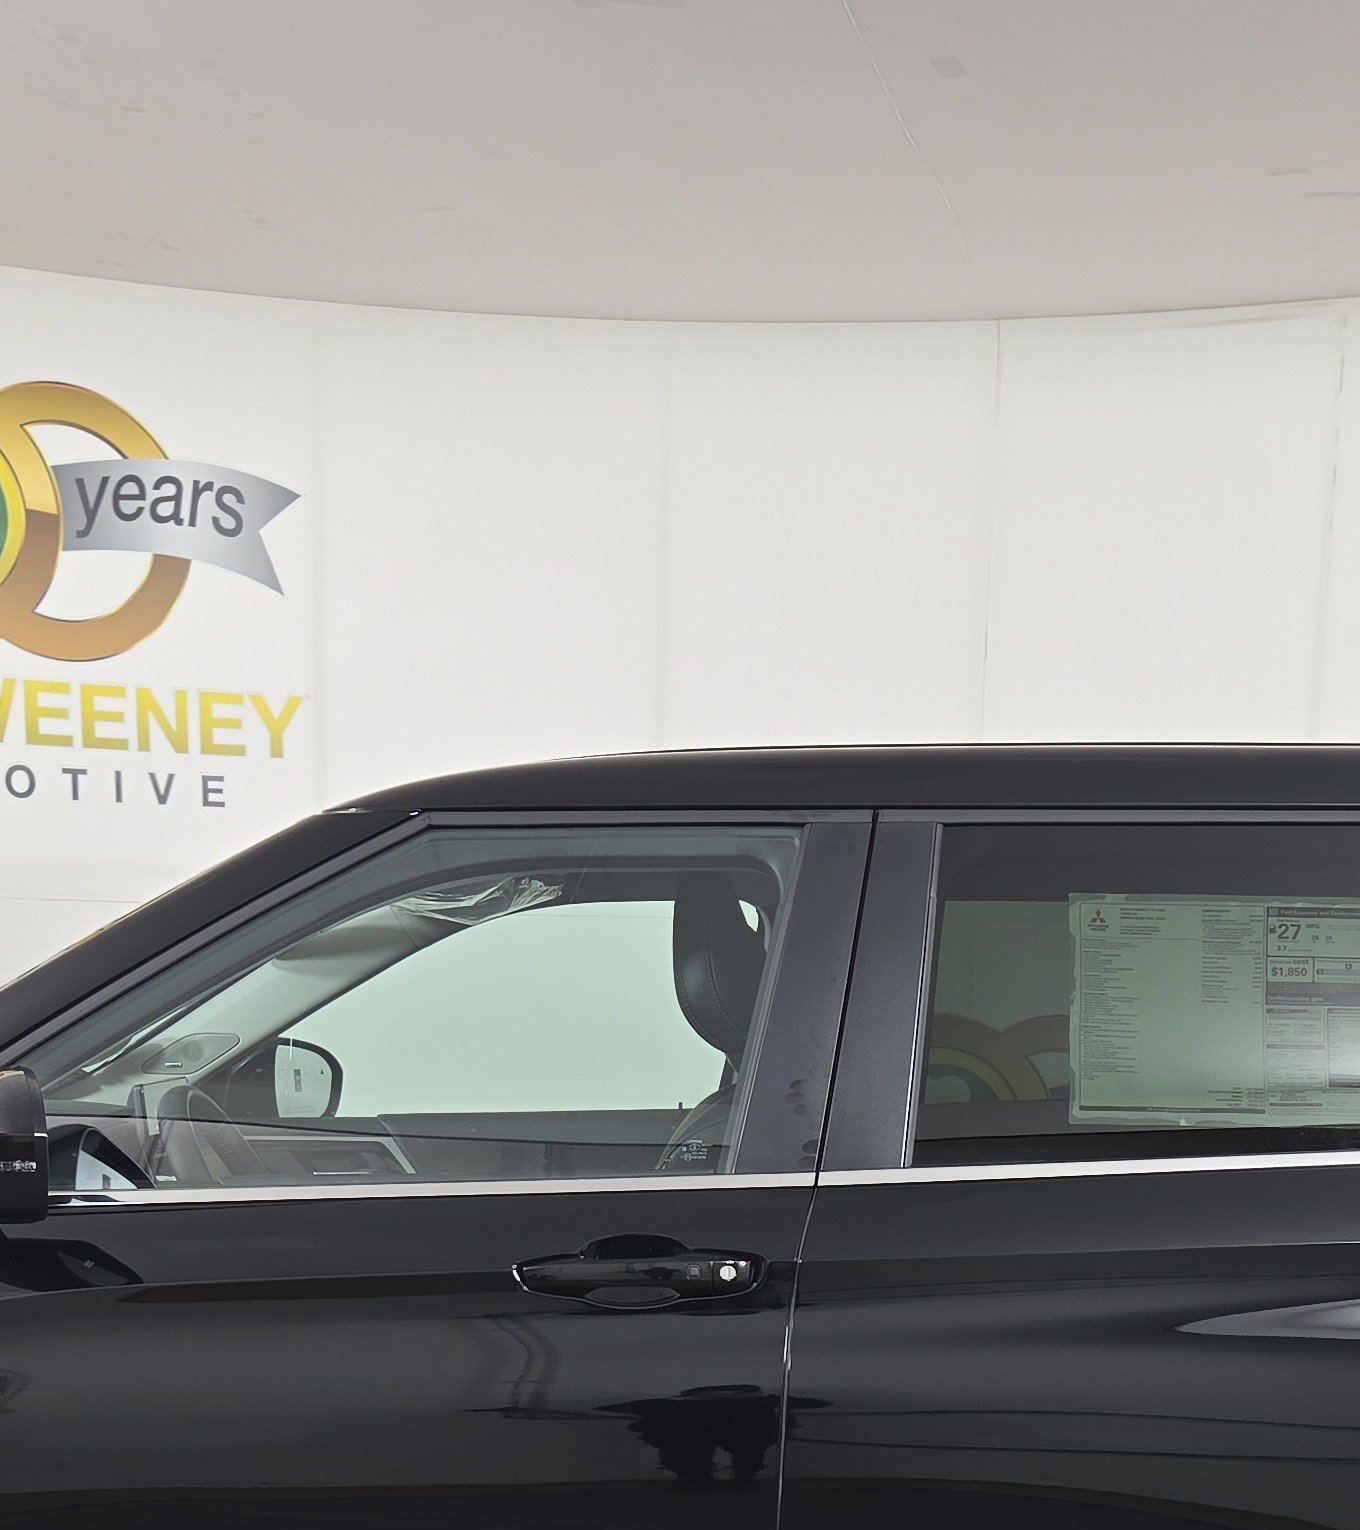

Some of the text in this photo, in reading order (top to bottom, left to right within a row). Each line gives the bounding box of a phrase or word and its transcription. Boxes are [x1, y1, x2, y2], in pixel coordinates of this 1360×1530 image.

[74, 472, 245, 539] years
[1277, 923, 1302, 940] 27
[1271, 967, 1307, 977] $1,850
